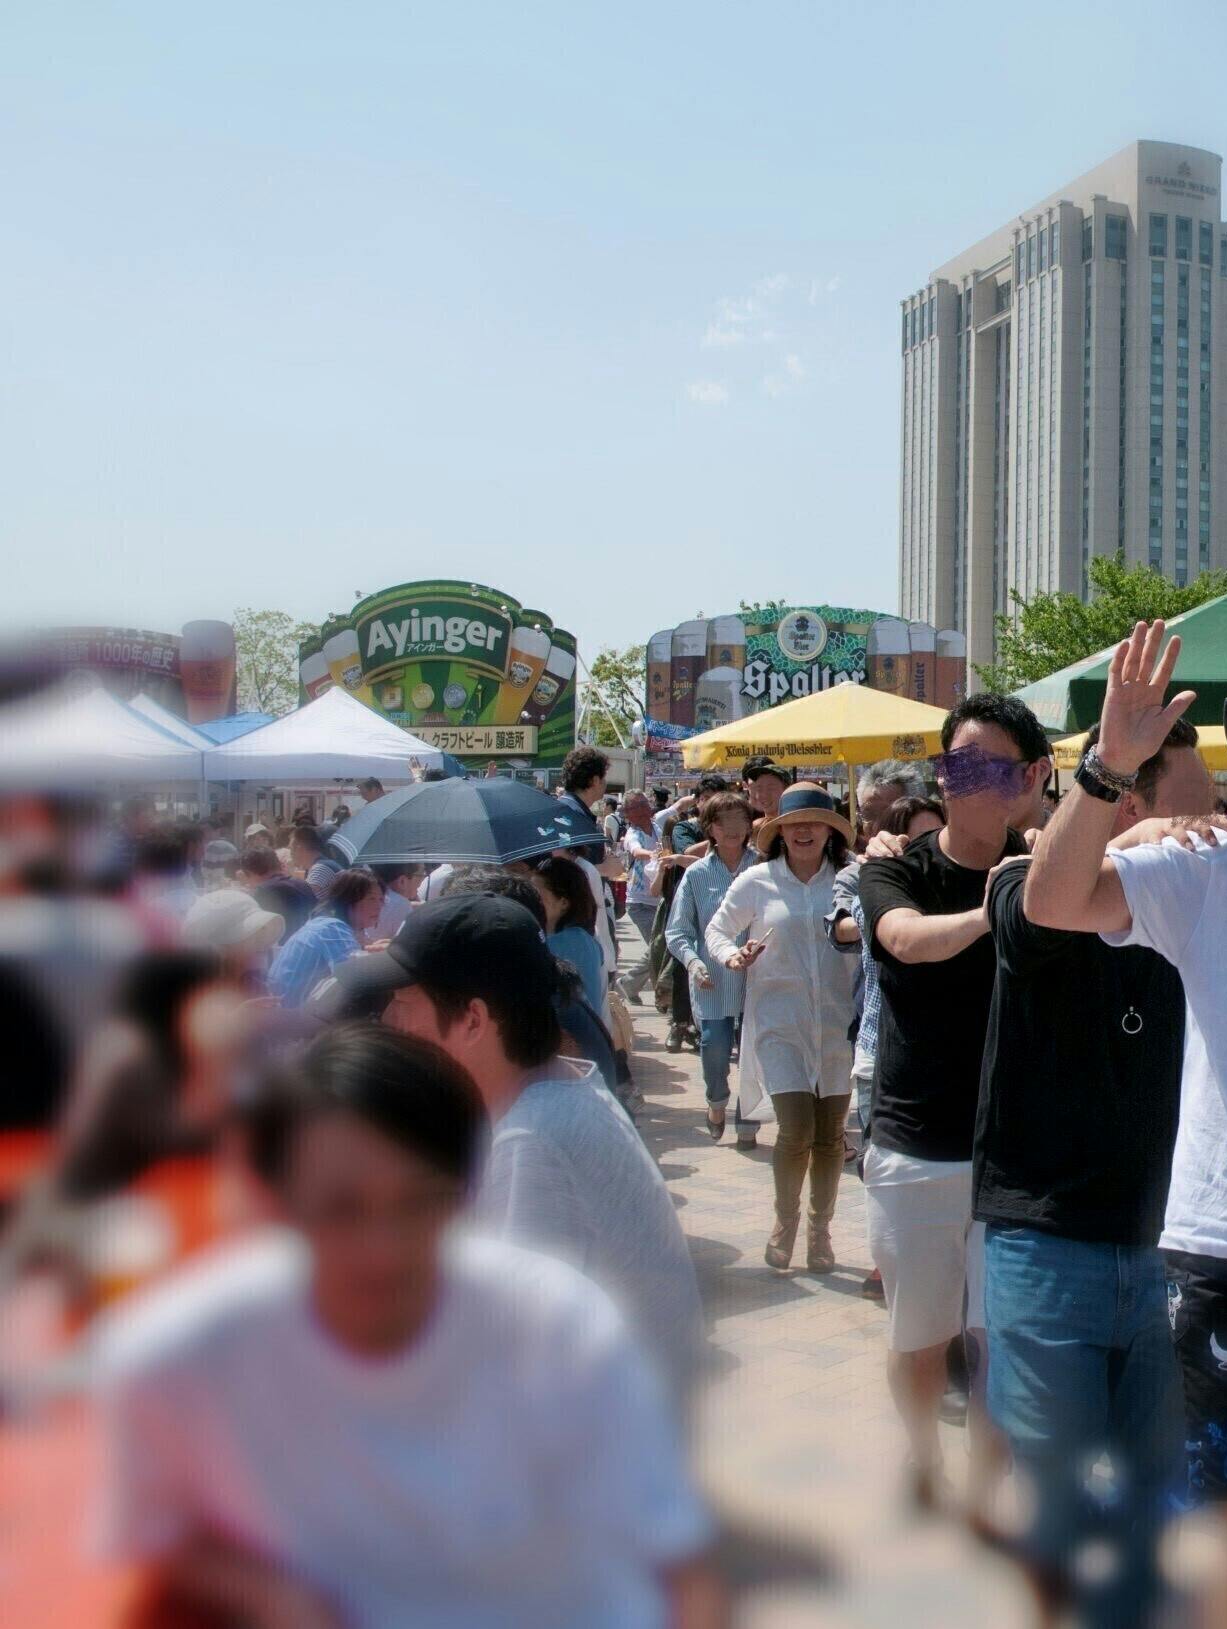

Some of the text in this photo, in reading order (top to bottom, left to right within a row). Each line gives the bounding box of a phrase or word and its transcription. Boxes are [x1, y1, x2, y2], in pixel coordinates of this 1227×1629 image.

[367, 608, 503, 657] Ayinger
[741, 658, 866, 704] Spalter
[433, 731, 493, 749] クラフトビール
